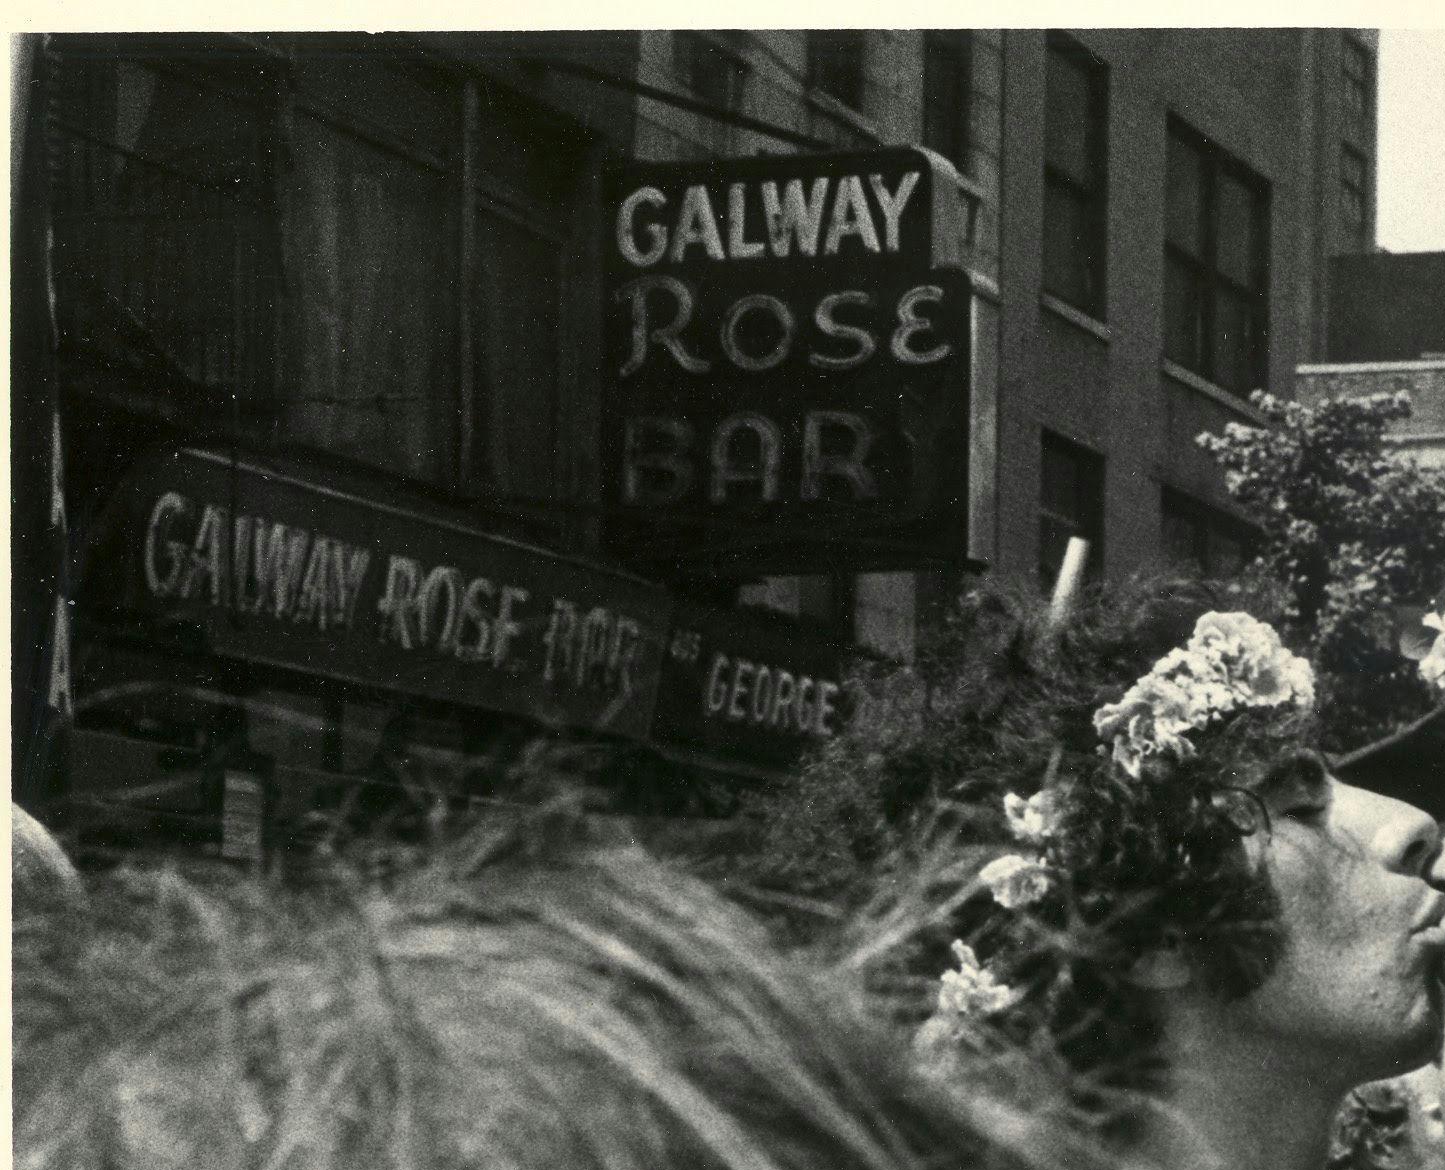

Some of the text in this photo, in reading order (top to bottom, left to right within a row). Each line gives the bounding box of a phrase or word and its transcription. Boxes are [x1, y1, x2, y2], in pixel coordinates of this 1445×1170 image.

[615, 170, 921, 267] GALWAY
[614, 274, 953, 378] ROSE
[622, 410, 878, 506] BAR
[143, 491, 371, 632] GALWAY
[379, 554, 530, 668] ROSE
[705, 651, 839, 736] GEORGE
